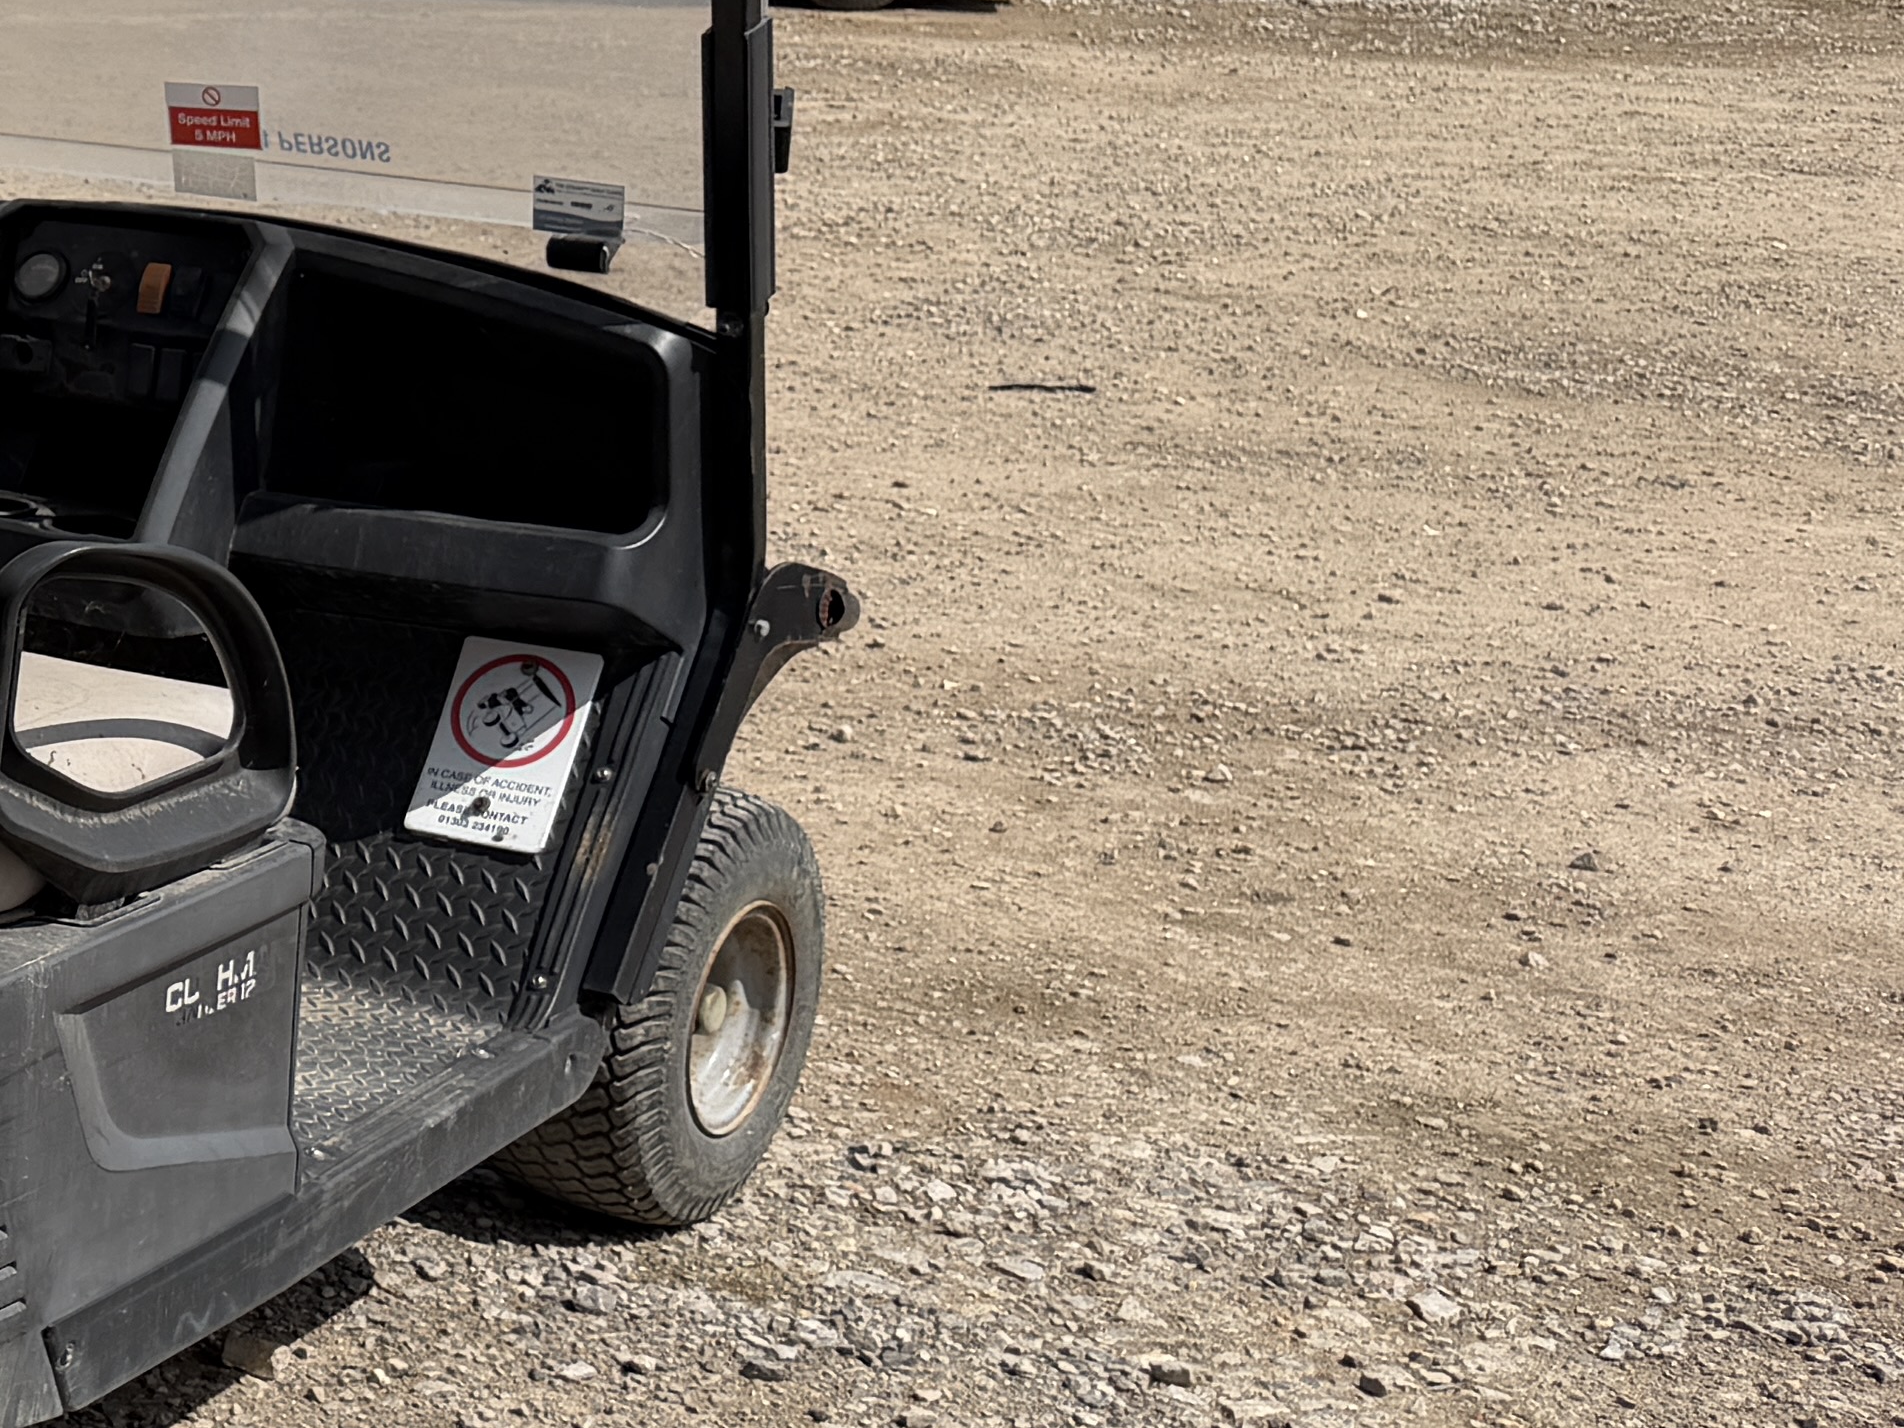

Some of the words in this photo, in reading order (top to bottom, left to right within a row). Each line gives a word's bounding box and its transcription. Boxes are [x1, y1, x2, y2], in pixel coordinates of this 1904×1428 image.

[177, 112, 217, 126] Speed
[220, 115, 251, 128] Limit
[194, 131, 203, 141] 5
[206, 131, 237, 143] MPH
[427, 767, 438, 776] IN
[442, 768, 473, 781] CASE
[474, 775, 492, 786] OF
[431, 780, 477, 797] ILLNESS
[478, 789, 496, 800] OR
[498, 791, 542, 807] INJURY
[479, 809, 529, 825] ONTACT
